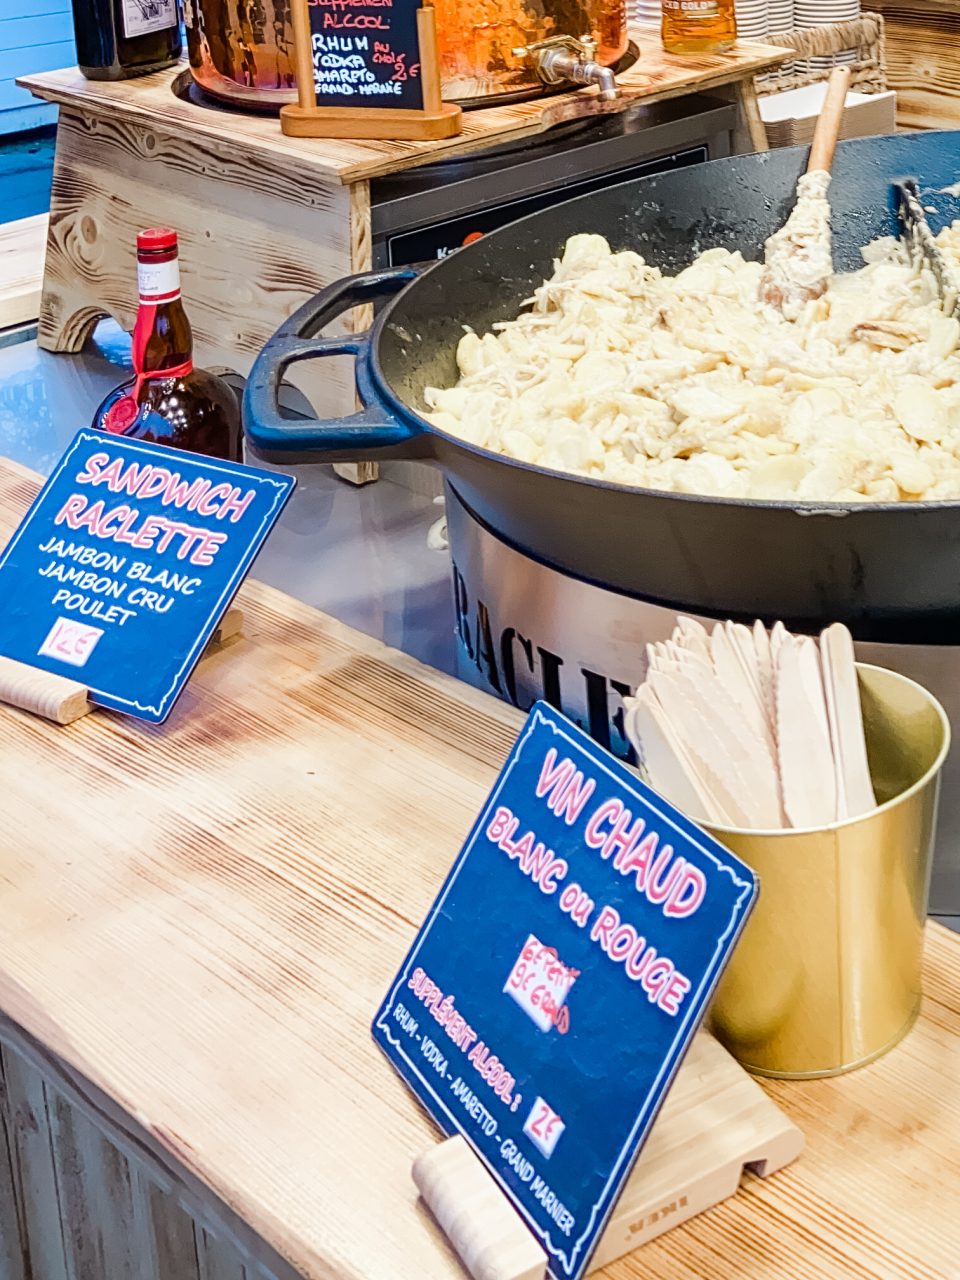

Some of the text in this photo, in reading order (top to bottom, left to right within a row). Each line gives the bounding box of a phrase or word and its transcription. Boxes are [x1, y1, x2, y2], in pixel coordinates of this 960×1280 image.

[311, 33, 369, 52] RHUM
[312, 52, 366, 68] VODKA
[76, 452, 256, 523] SANDWICH
[54, 493, 228, 565] RACLETTE
[38, 561, 175, 613] JAMBON CRU
[39, 537, 201, 595] JAMBON BLANC
[52, 589, 137, 625] POULET
[452, 558, 640, 769] RACLE
[535, 747, 707, 918] VIN CHAUD
[486, 806, 691, 1016] BLANC ou ROUGE
[407, 967, 478, 1053] SUPPLÉMENT
[467, 1041, 517, 1105] ALCOOL
[392, 1002, 419, 1037] RHUM
[420, 1036, 449, 1080] VODKA
[449, 1076, 498, 1137] AMARETTO
[500, 1138, 535, 1183] GRAND
[530, 1175, 576, 1237] MARNIER
[530, 1106, 563, 1140] 2€
